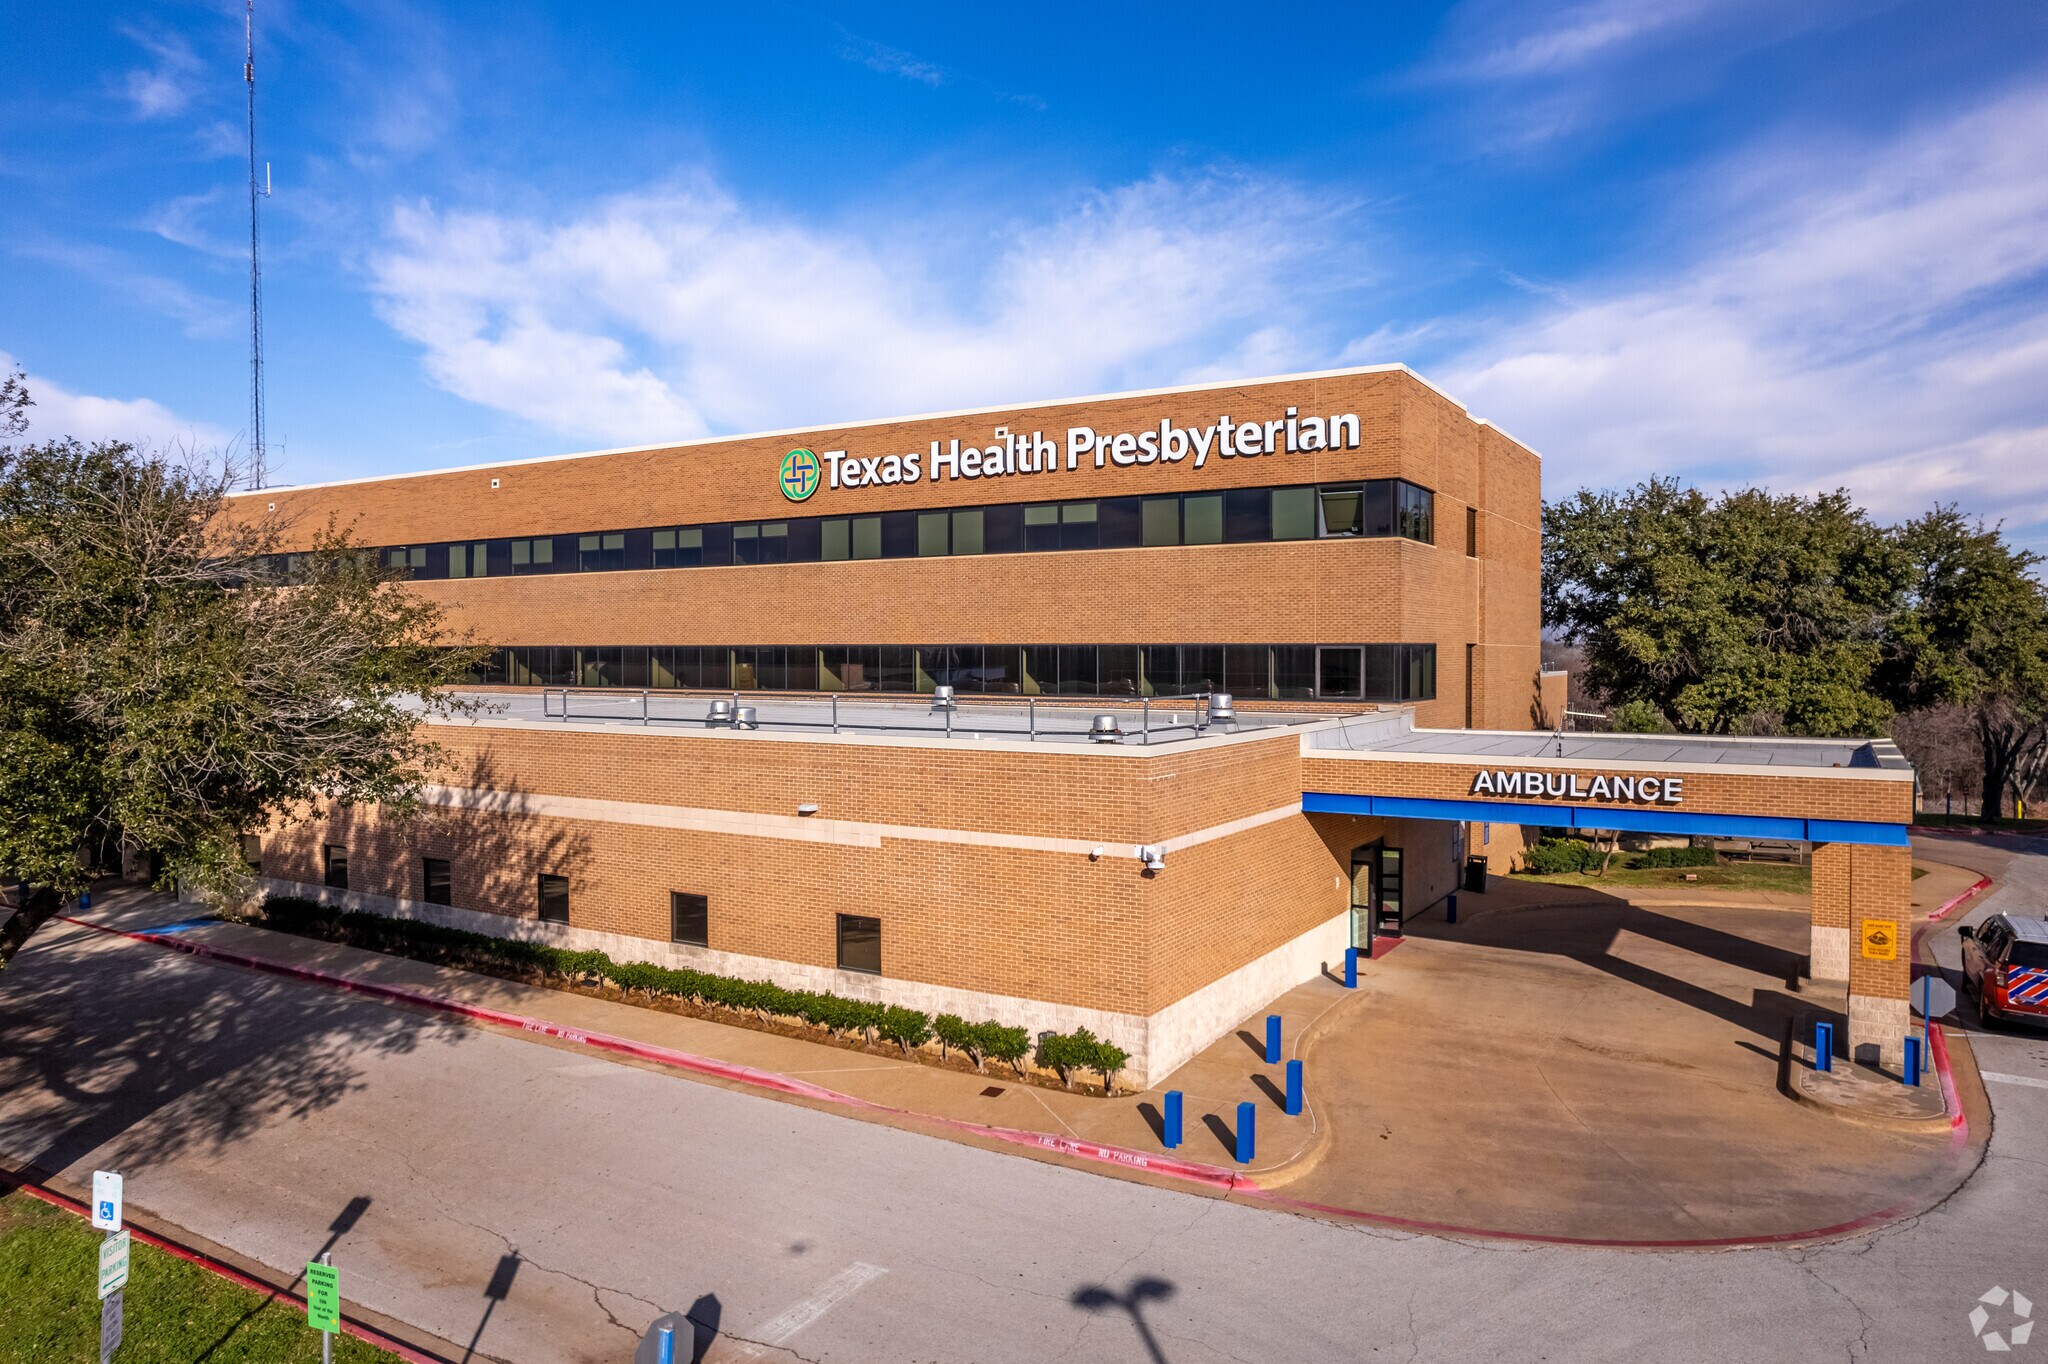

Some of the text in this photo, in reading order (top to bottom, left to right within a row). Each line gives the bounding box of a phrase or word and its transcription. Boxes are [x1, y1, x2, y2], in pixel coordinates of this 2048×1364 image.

[823, 406, 1361, 489] Texas Health Presbyterian
[1472, 770, 1684, 802] AMBULANCE
[1038, 1136, 1148, 1167] FIRE LANE NO PARKING
[103, 1237, 127, 1259] VISITOR
[101, 1257, 127, 1280] PARKING
[310, 1269, 335, 1279] RESERVED
[312, 1279, 333, 1288] PARKING
